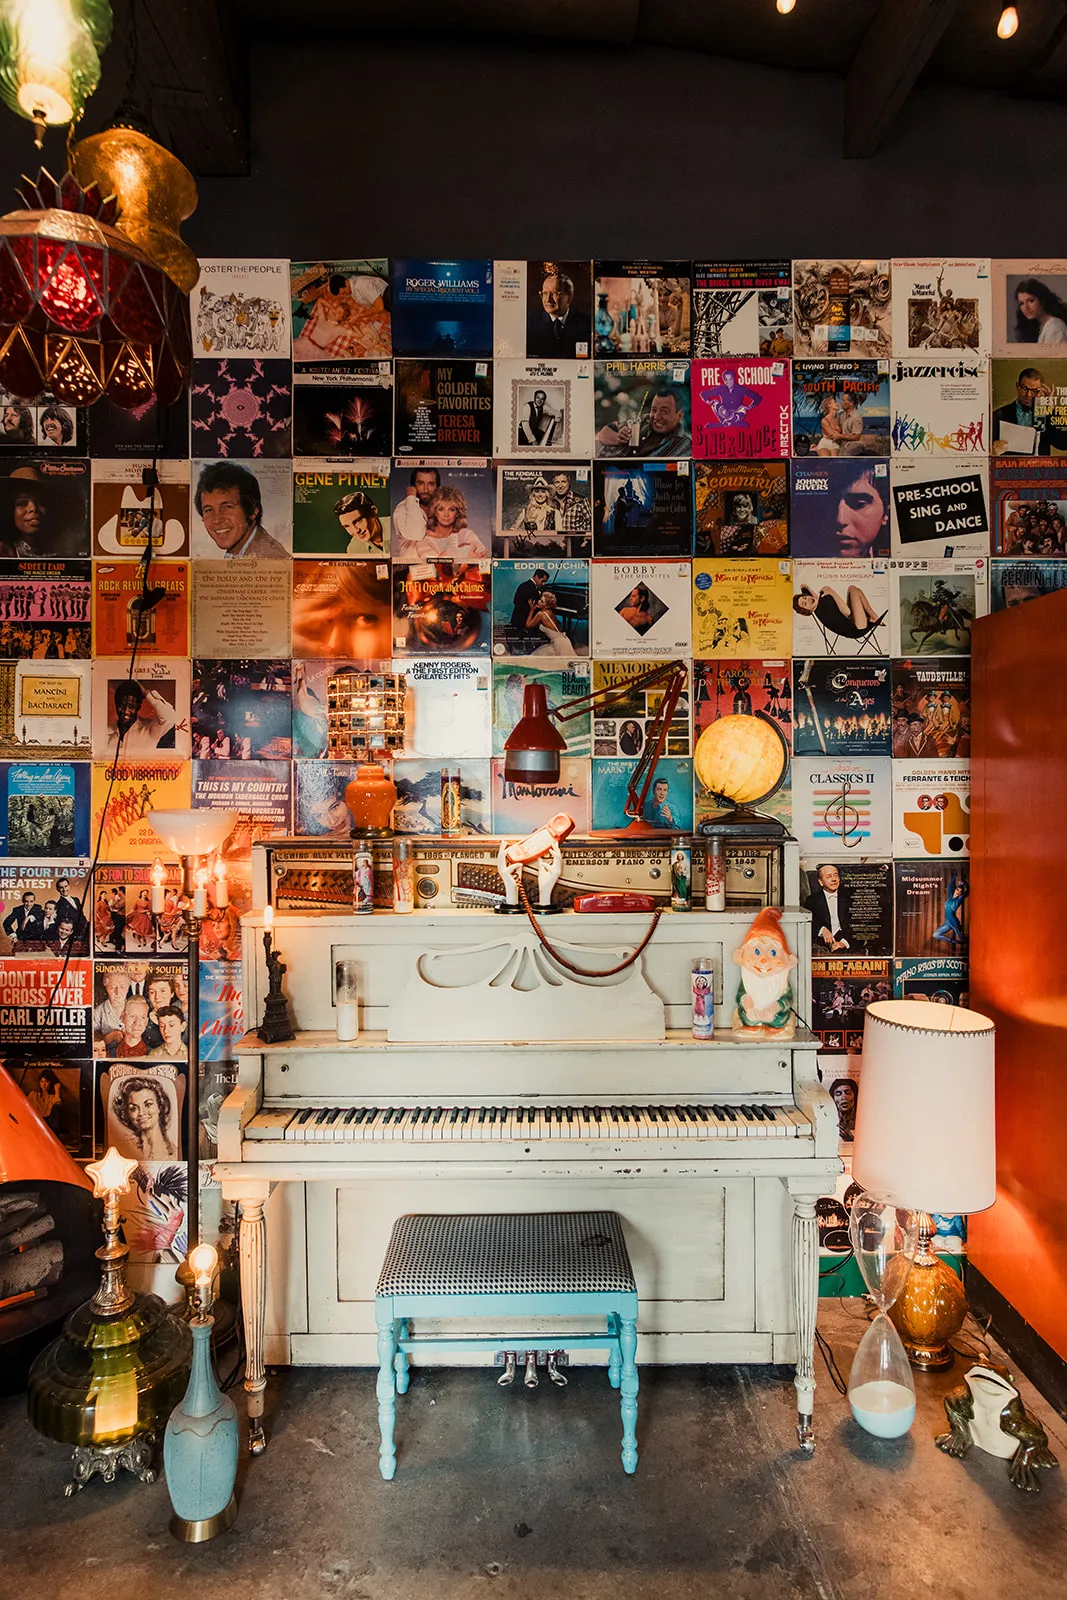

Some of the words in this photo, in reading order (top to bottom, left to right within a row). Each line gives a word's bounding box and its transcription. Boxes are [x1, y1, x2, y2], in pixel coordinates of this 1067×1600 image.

[406, 278, 438, 288] ROGER
[437, 279, 480, 288] WILLIAMS
[696, 279, 707, 287] THE
[731, 279, 741, 287] ON
[742, 279, 753, 287] THE
[606, 362, 629, 371] PHIL
[630, 362, 667, 371] HARRIS
[829, 363, 853, 371] STEREO
[438, 368, 453, 381] MY
[701, 367, 721, 387] PRE
[438, 382, 478, 395] GOLDEN
[803, 380, 836, 393] SOUTH
[843, 379, 881, 393] PACIFIC
[438, 397, 491, 410] FAVORITES
[1039, 396, 1058, 406] BEST
[438, 415, 475, 428] TERESA
[779, 405, 789, 448] VOLUME
[438, 429, 481, 443] BREWER
[295, 472, 334, 486] GENE
[338, 472, 388, 487] PITNEY
[897, 481, 979, 503] PRE-SCHOOL
[909, 504, 942, 519] SING
[946, 502, 968, 513] AND
[934, 515, 983, 533] DANCE
[18, 563, 48, 571] STREET
[47, 562, 66, 571] FAIR
[514, 562, 545, 570] EDDIE
[547, 562, 588, 570] DUCHIN
[614, 566, 657, 574] BOBBY
[98, 580, 120, 591] ROCK
[155, 580, 185, 591] GREATS
[423, 581, 445, 596] Organ
[459, 581, 484, 593] Chimes
[916, 671, 967, 683] VAUDEVILLE!
[33, 688, 67, 696] MANCINI
[562, 683, 590, 697] BEAUTY
[27, 701, 73, 709] BACHARACH
[104, 769, 129, 781] GOOD
[129, 769, 179, 781] VIBRATIONS
[597, 766, 626, 774] MARIO
[809, 773, 864, 784] CLASSICS
[865, 773, 875, 784] II
[197, 781, 220, 792] THIS
[219, 781, 230, 792] IS
[231, 782, 248, 792] MY
[247, 782, 289, 793] COUNTRY
[497, 773, 582, 801] Mantovani
[450, 851, 485, 859] FLANGED
[19, 867, 51, 877] FOUR
[54, 867, 89, 878] LADS'
[108, 868, 123, 881] FUN
[124, 868, 133, 881] TO
[95, 964, 125, 973] SUNDAY
[127, 964, 153, 973] DOWN
[155, 964, 182, 974] SOUTH
[917, 960, 937, 973] RAGS
[937, 959, 946, 969] BY
[945, 959, 967, 972] SCOTT
[0, 970, 36, 988] DON'T
[41, 970, 62, 988] LET
[66, 970, 87, 988] ME
[3, 987, 47, 1005] CROSS
[50, 987, 83, 1005] OVER
[0, 1008, 34, 1026] CARL
[36, 1008, 87, 1026] BUTLER
[214, 1074, 231, 1084] The
